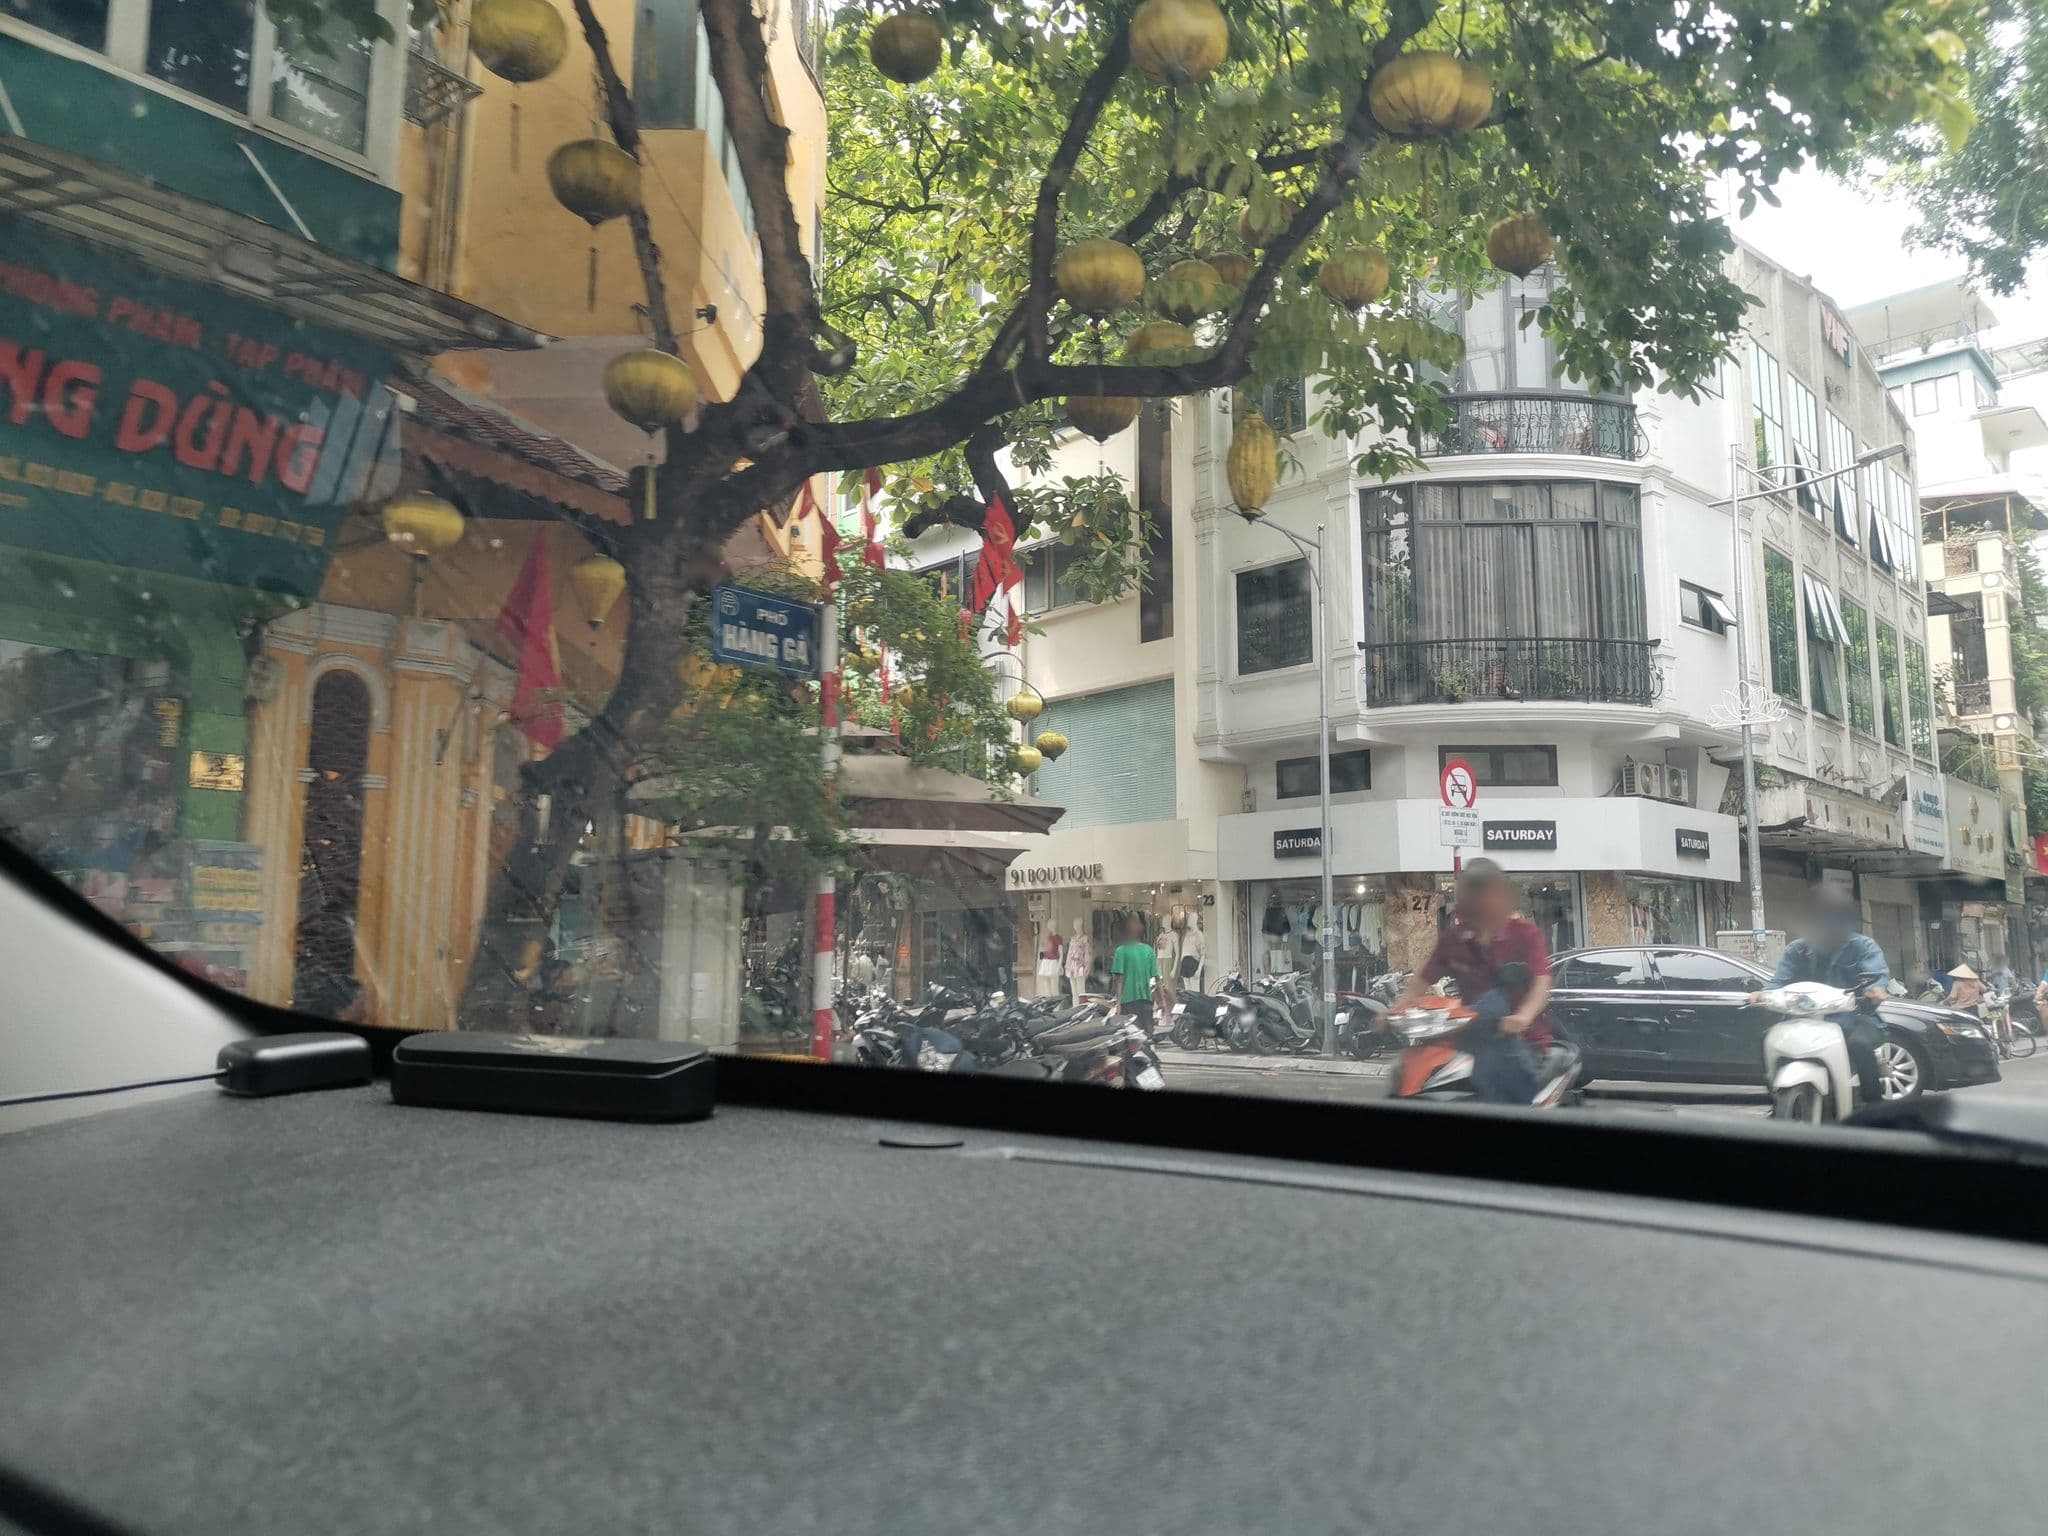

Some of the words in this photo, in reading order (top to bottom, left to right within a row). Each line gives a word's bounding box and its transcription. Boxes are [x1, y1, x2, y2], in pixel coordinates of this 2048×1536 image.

[116, 377, 326, 494] DÙNG
[756, 608, 789, 626] PHỐ
[721, 620, 779, 659] HÀNG
[781, 633, 810, 665] GÀ
[1276, 837, 1321, 850] SATURDA
[1487, 829, 1553, 841] SATURDAY
[1680, 837, 1708, 851] SATURDAY
[1010, 869, 1025, 885] 91
[1027, 862, 1104, 884] BOUTIQUE
[1203, 894, 1216, 906] 23
[1412, 895, 1432, 914] 27
